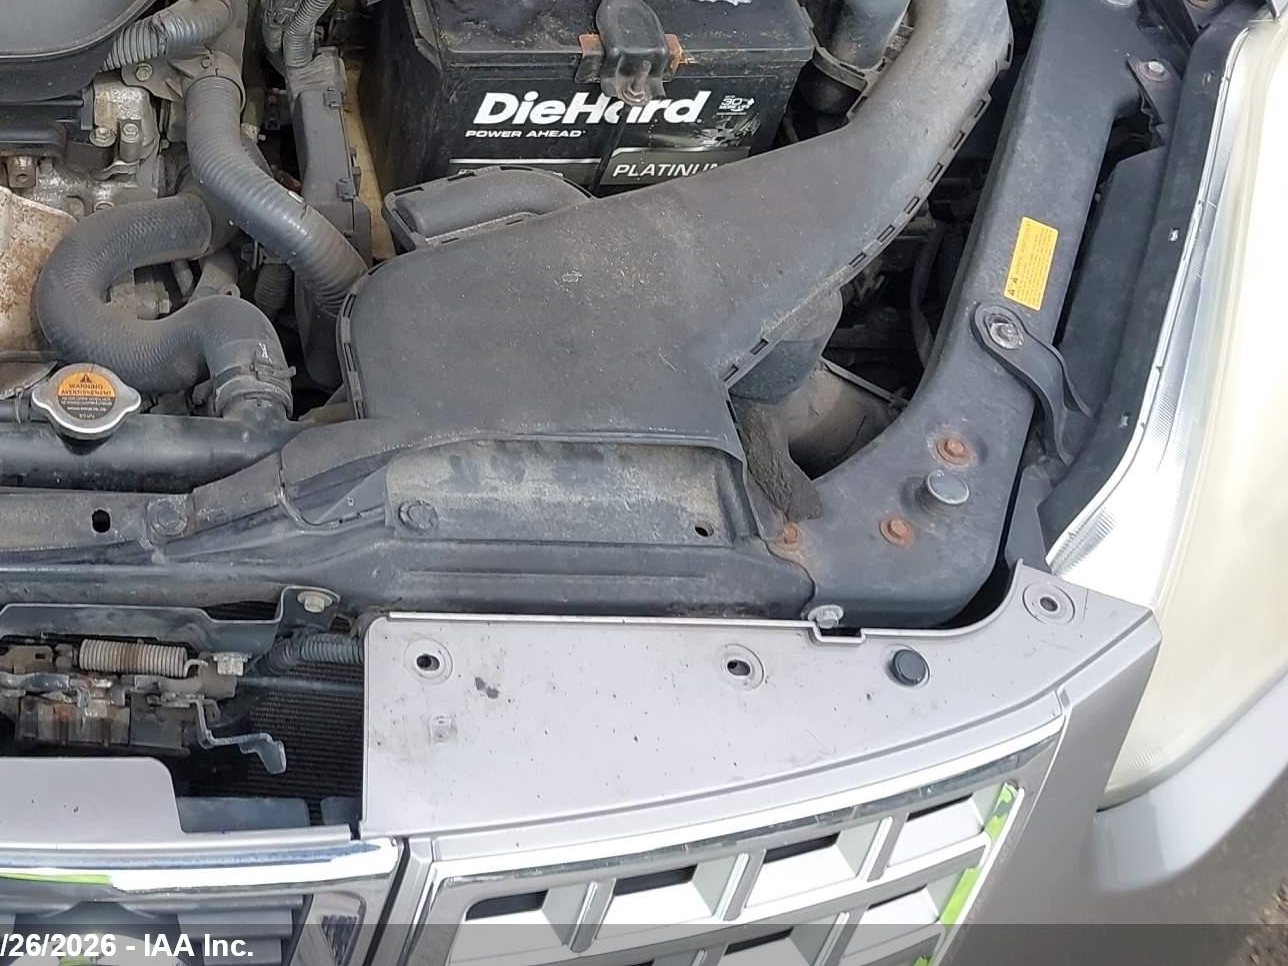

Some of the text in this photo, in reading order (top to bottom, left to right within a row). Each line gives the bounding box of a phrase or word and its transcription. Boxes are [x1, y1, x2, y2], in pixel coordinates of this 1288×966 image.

[472, 90, 712, 125] DieHard
[465, 129, 582, 138] POWER AHEAD
[612, 162, 719, 178] PLATINU
